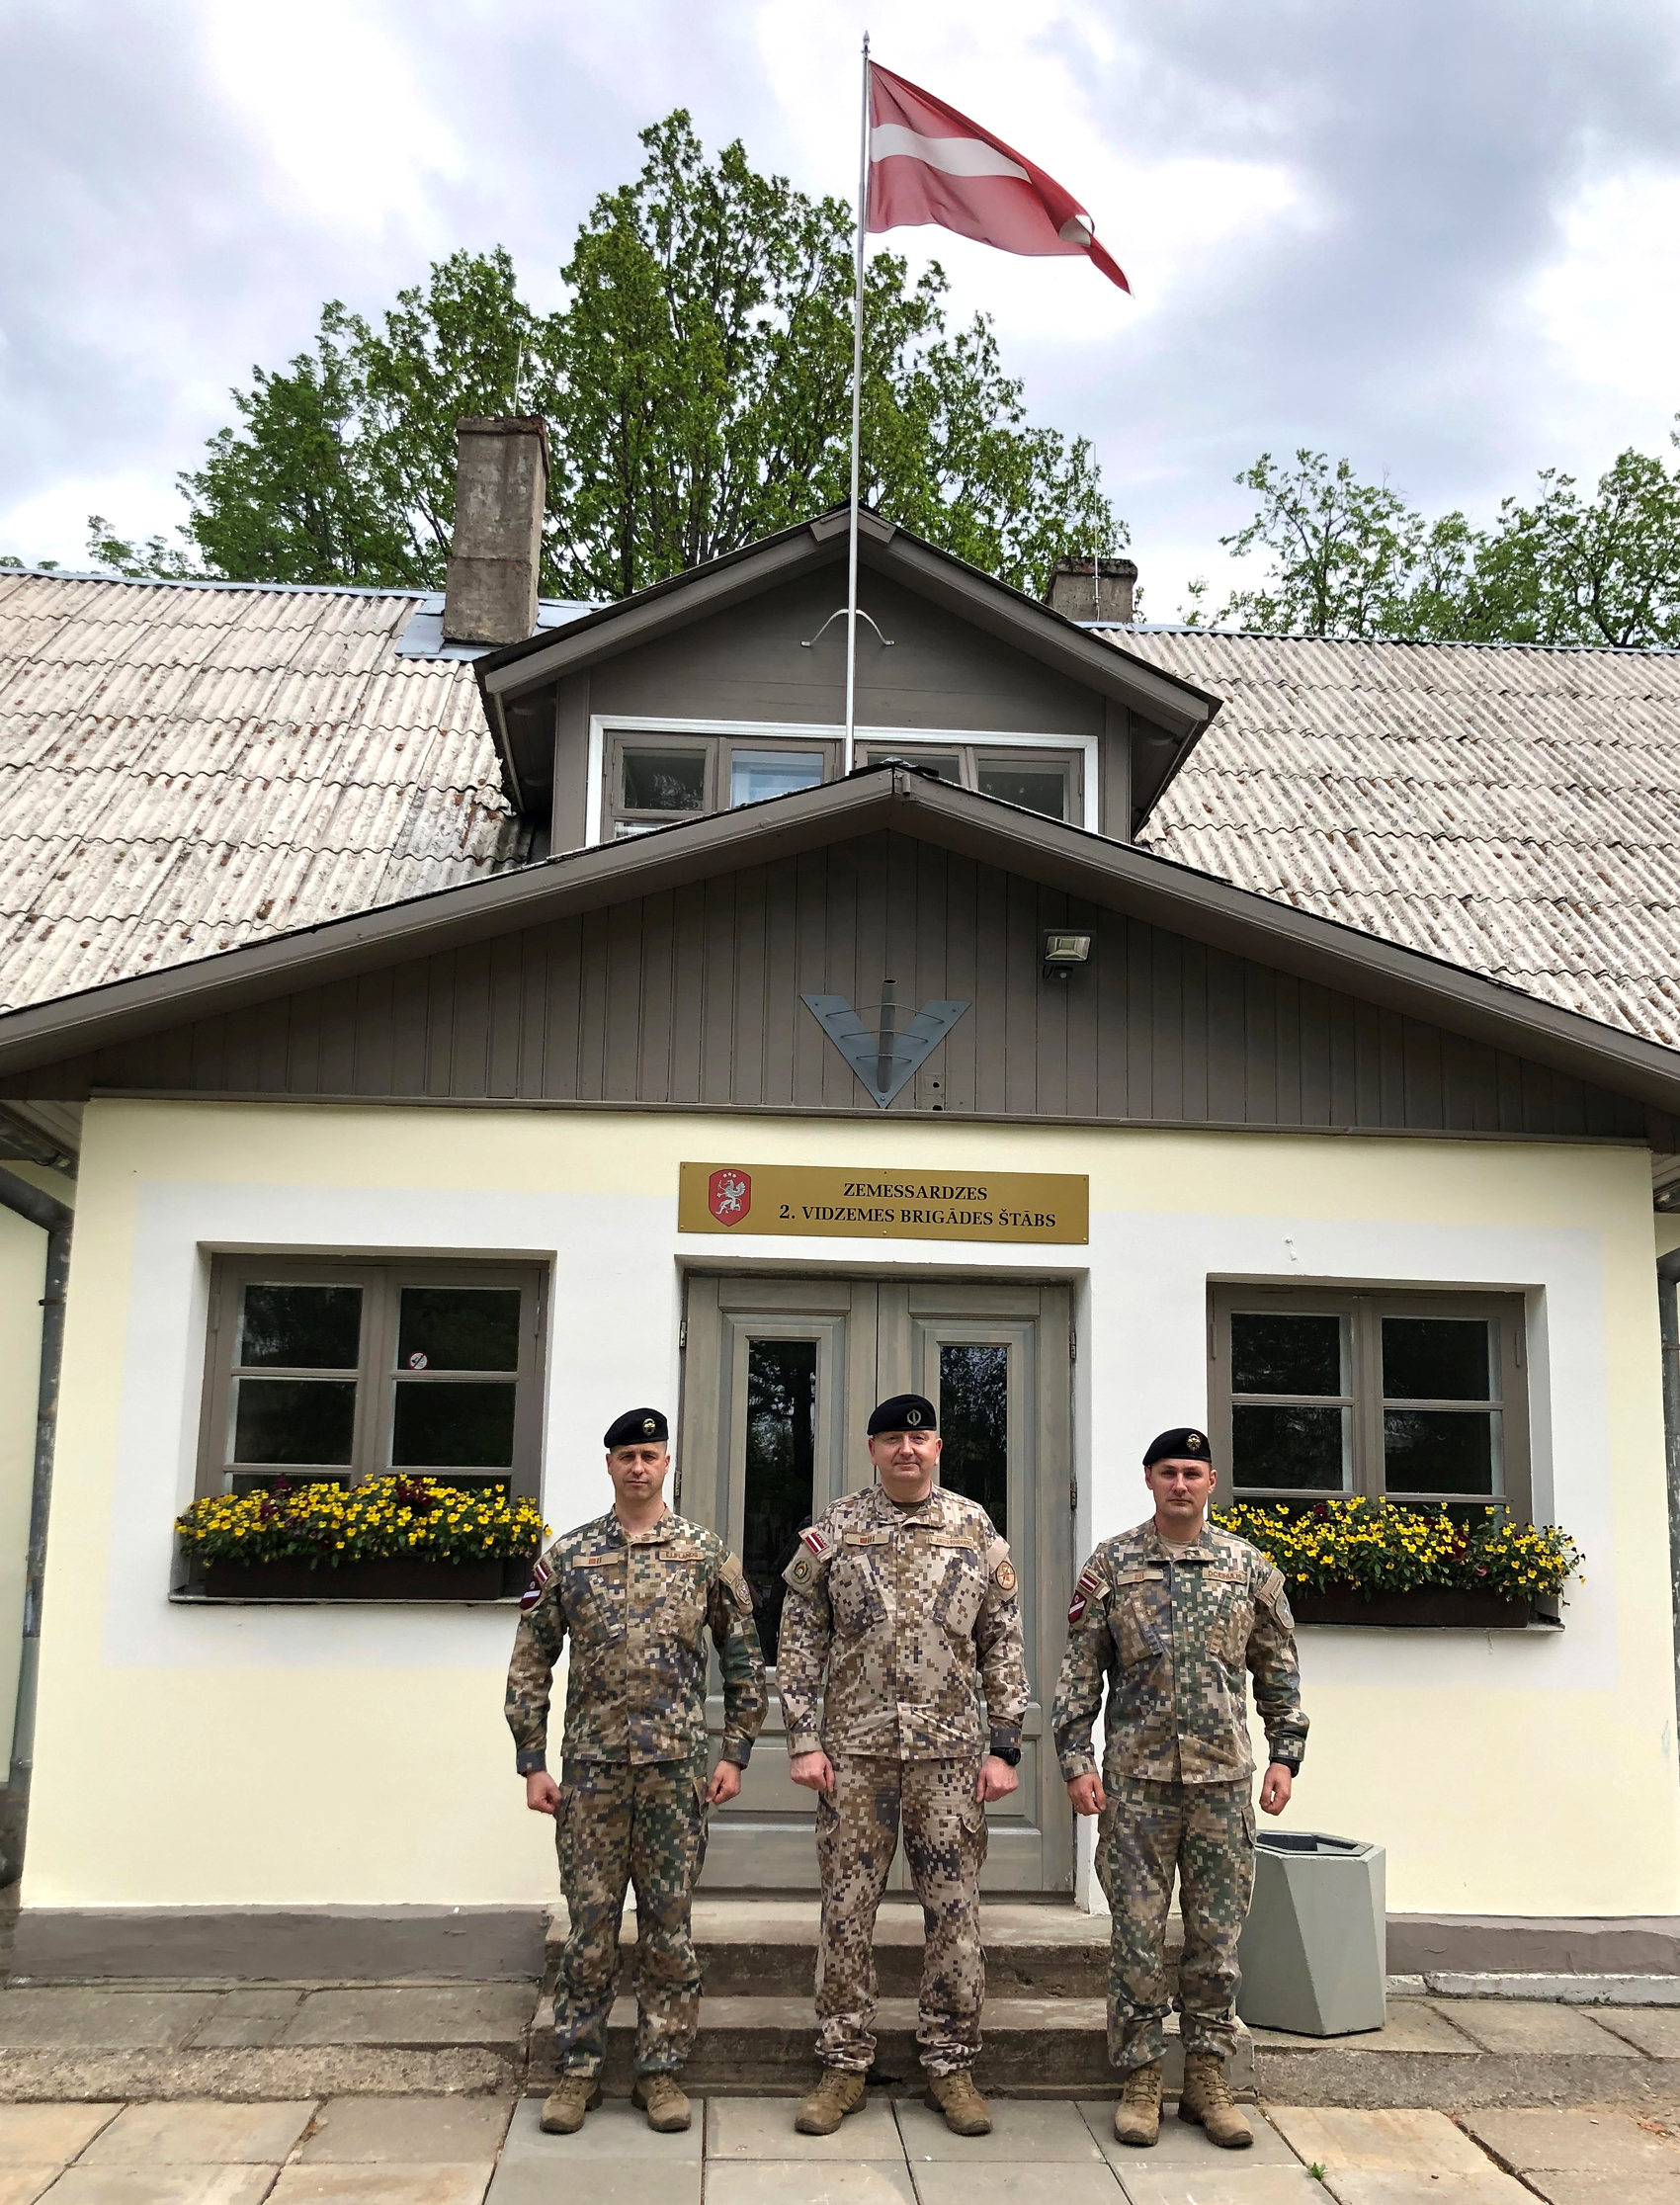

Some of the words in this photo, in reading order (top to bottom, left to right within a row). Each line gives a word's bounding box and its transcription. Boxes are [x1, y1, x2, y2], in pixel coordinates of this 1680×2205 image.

[843, 1182, 987, 1201] ZEMESSARDZES
[779, 1203, 796, 1221] 2.
[801, 1205, 895, 1224] VIDZEMES
[899, 1207, 994, 1227] BRIGĀDES
[998, 1207, 1056, 1228] ŠTĀBS
